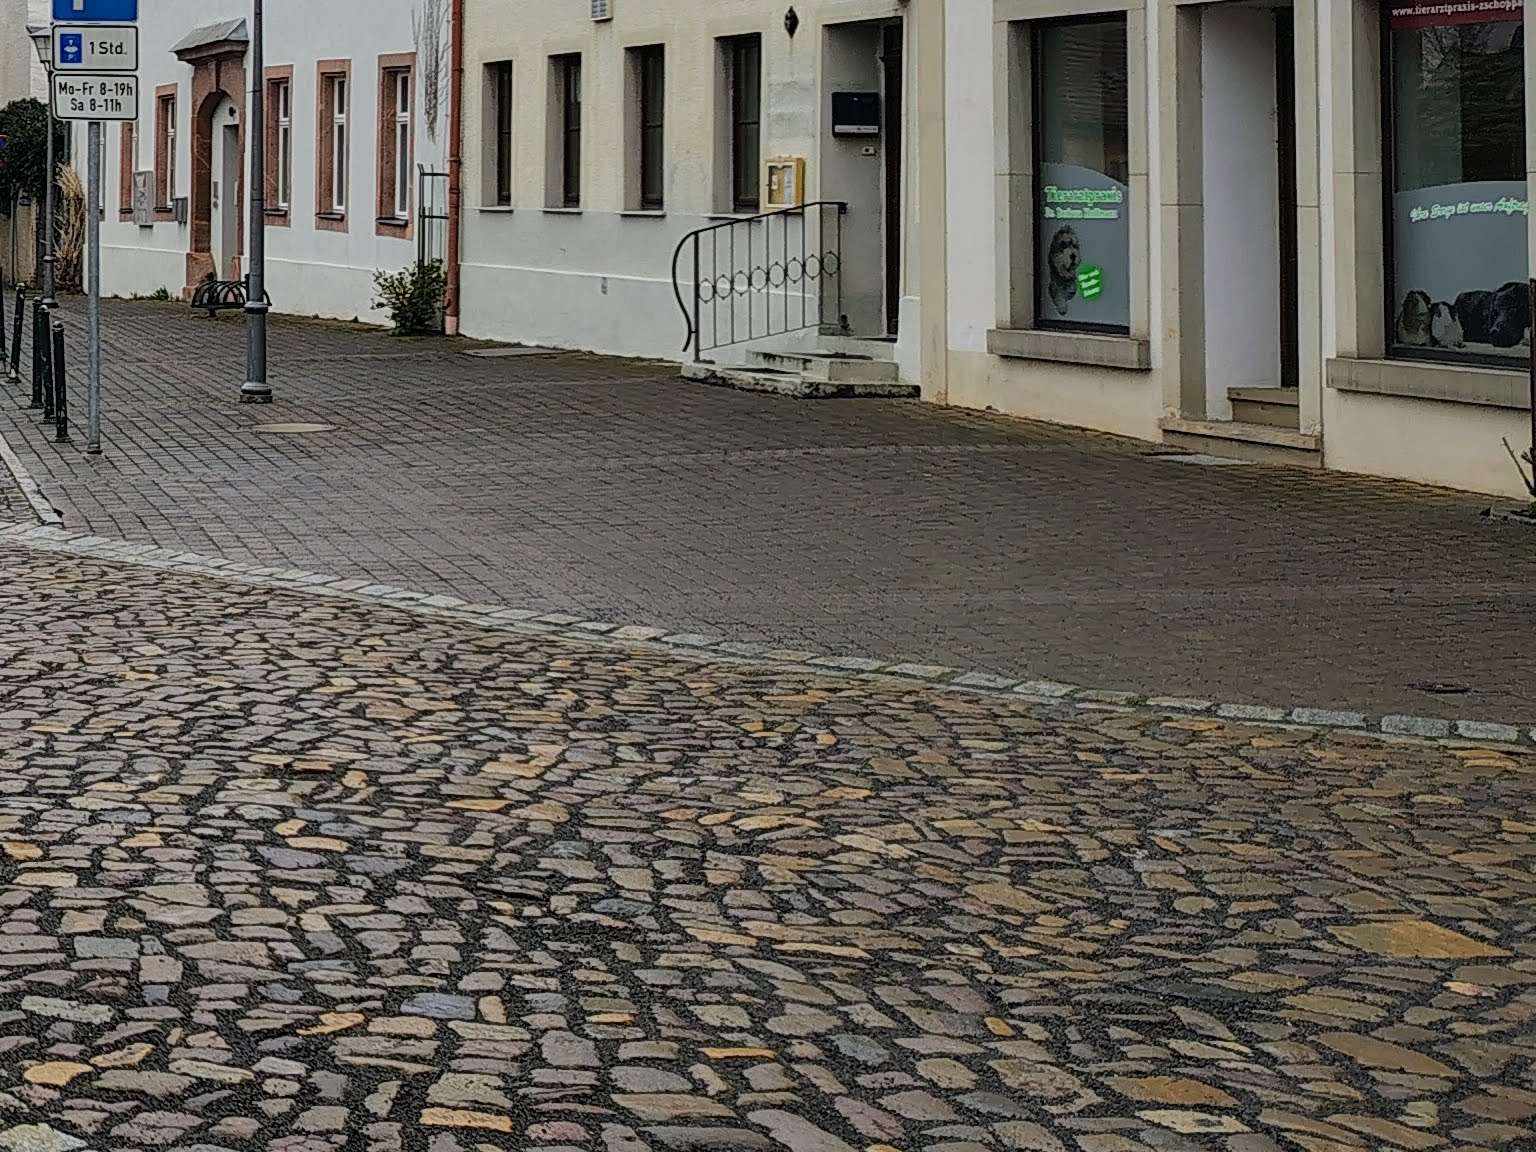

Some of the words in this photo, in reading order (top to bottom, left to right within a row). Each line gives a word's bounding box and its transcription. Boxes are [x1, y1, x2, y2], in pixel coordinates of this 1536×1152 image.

[89, 41, 95, 55] 1
[99, 41, 128, 55] Std.
[58, 81, 94, 97] Mo-Fr
[99, 81, 133, 97] 8-19h
[70, 98, 84, 112] Sa
[89, 98, 122, 112] 8-11h
